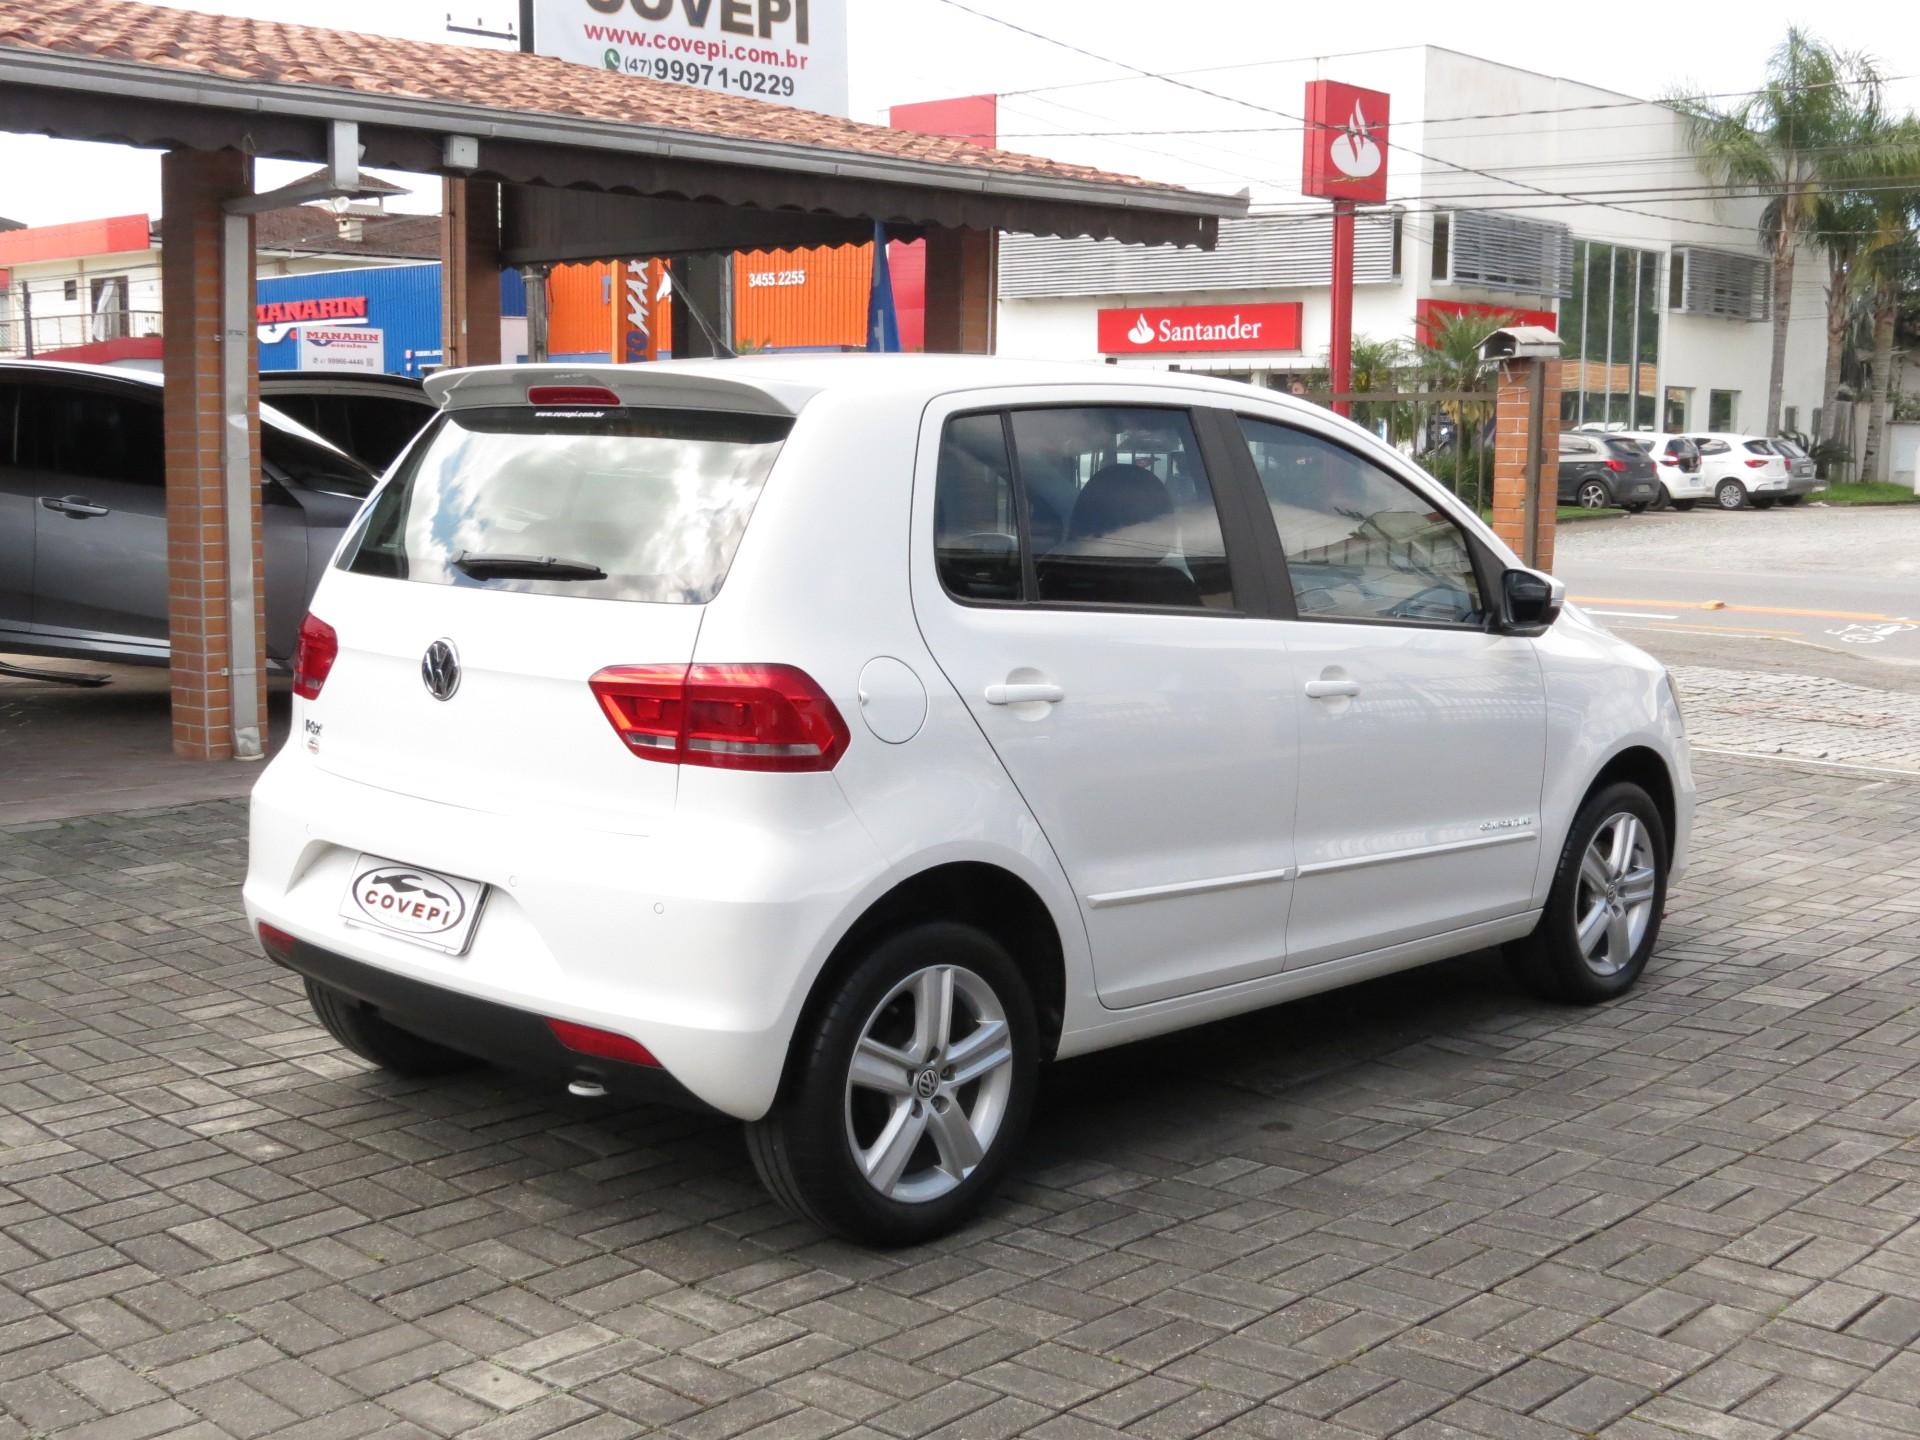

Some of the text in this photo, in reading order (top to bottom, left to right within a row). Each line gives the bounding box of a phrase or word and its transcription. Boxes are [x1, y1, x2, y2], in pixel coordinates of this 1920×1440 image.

[583, 0, 809, 45] VEPI
[584, 23, 808, 70] www.covepi.com.br
[654, 58, 795, 97] 99971-0229
[749, 270, 805, 287] 3455.2255
[306, 331, 379, 341] MANARIN
[1158, 314, 1262, 342] Santander
[365, 890, 450, 925] COVEPI
